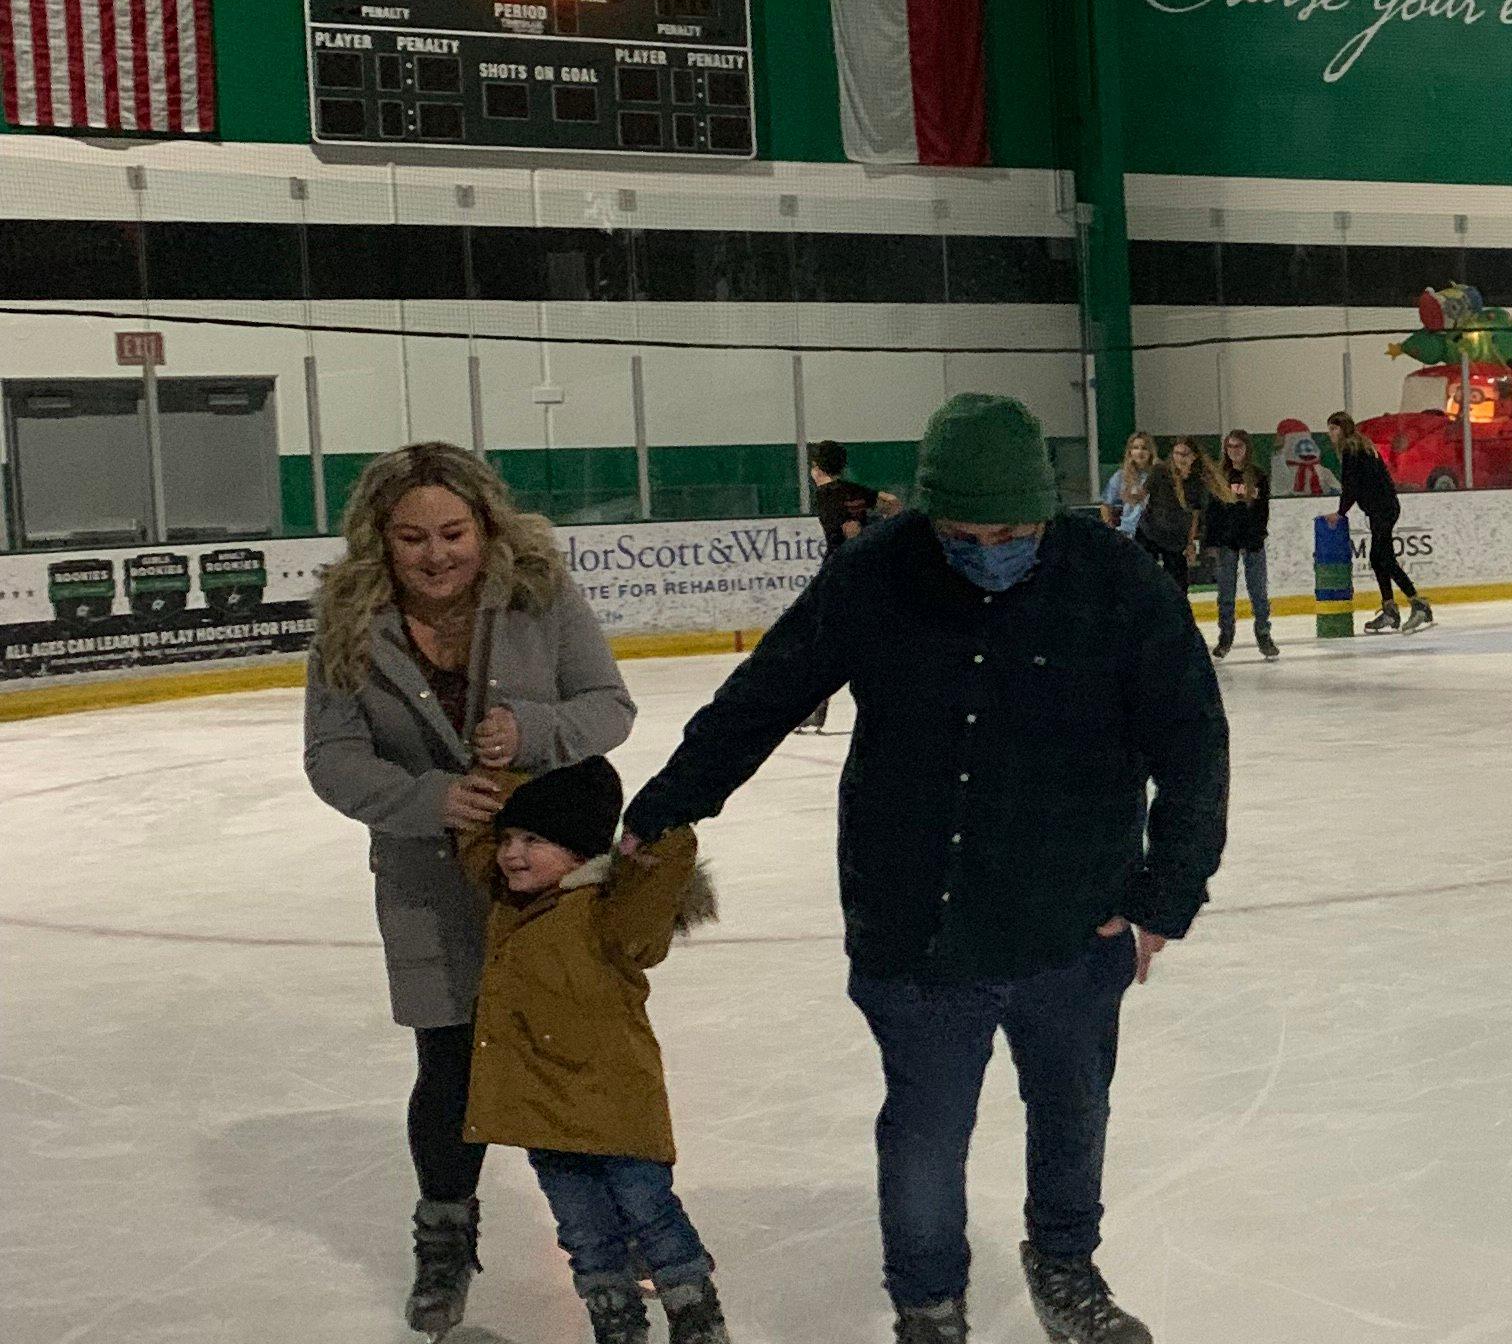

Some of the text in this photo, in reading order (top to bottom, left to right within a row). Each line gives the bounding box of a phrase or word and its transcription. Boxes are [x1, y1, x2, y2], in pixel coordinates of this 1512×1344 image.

[361, 6, 411, 20] PENALTY
[494, 2, 548, 20] PERIOD
[656, 23, 701, 37] PENALTY
[315, 31, 460, 54] PLAYER PENALTY
[615, 47, 745, 69] PLAYER PENALTY
[479, 62, 599, 83] SHOTS ON GOAL
[618, 583, 657, 598] FOR
[6, 644, 32, 659] ALL
[32, 641, 66, 656] AGES
[67, 637, 96, 654] CAN
[96, 634, 140, 651] LEARN
[141, 632, 159, 646] TO
[160, 629, 194, 645] PLAY
[196, 624, 250, 641] HOCKEY
[253, 621, 280, 636] FOR
